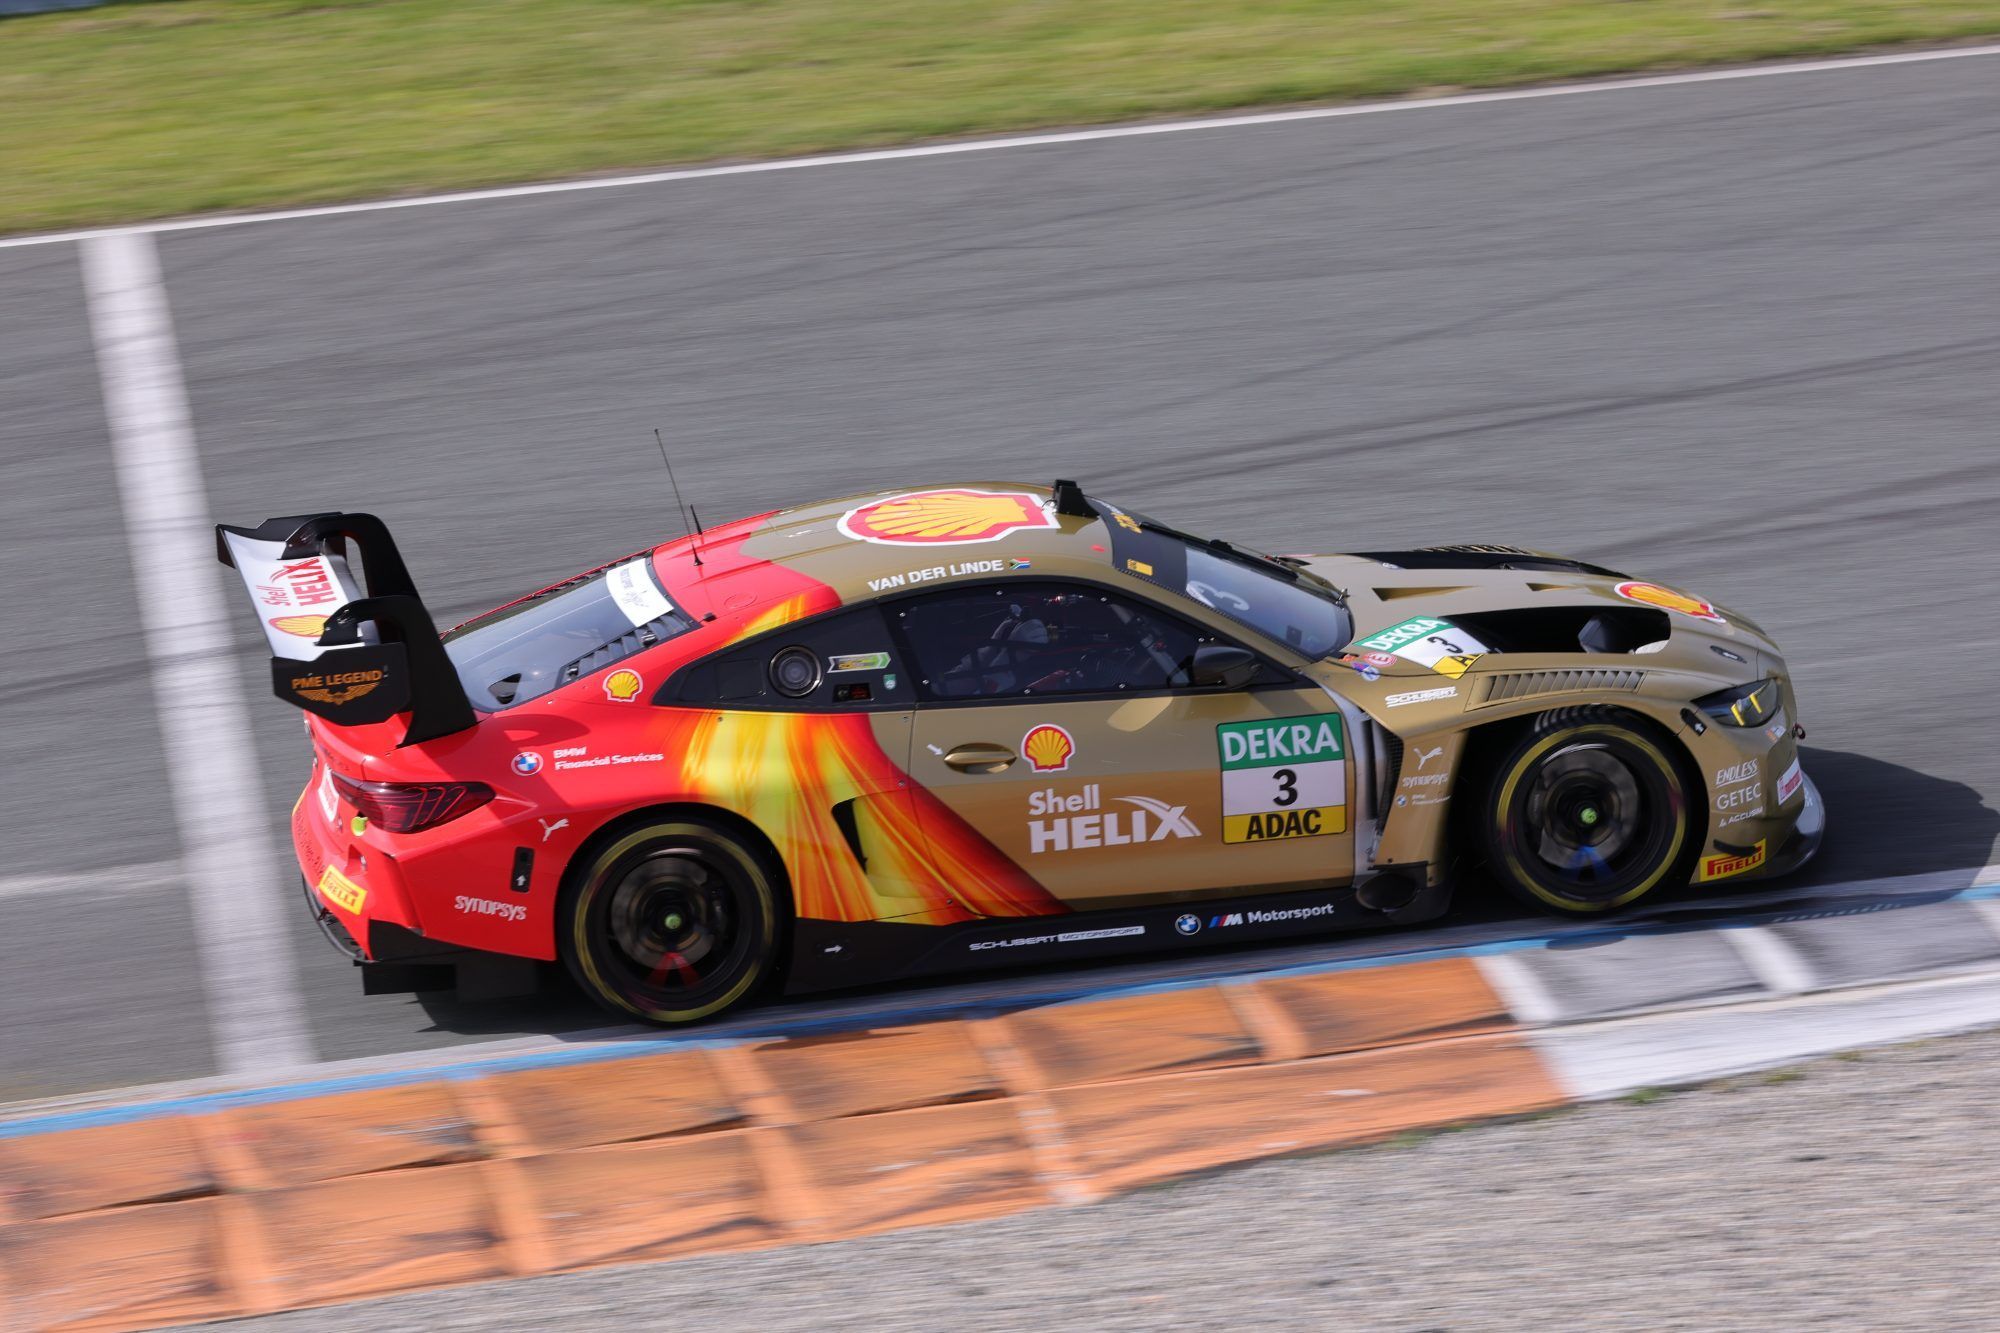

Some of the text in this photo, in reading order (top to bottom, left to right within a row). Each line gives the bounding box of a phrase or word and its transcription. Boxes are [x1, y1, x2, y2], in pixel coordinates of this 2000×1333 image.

[270, 558, 337, 606] HELIX
[867, 560, 1005, 592] VAN DER LINDE
[256, 585, 291, 607] Shell
[1361, 619, 1448, 651] DEKRA
[1427, 636, 1463, 653] 3
[291, 669, 383, 689] PME LEGEND
[553, 746, 586, 759] BMW
[1222, 721, 1340, 762] DEKRA
[554, 753, 664, 771] Financial Services
[1716, 758, 1759, 788] ENDLESS
[1028, 784, 1100, 815] Shell
[1272, 768, 1298, 806] 3
[1717, 782, 1762, 810] GETEC
[1027, 796, 1203, 854] HELIX
[1246, 808, 1322, 840] ADAC
[1707, 843, 1763, 876] PIRELLI
[1247, 904, 1335, 924] Motorsport
[969, 926, 1144, 950] SCHUBERT MOTORSPORT
